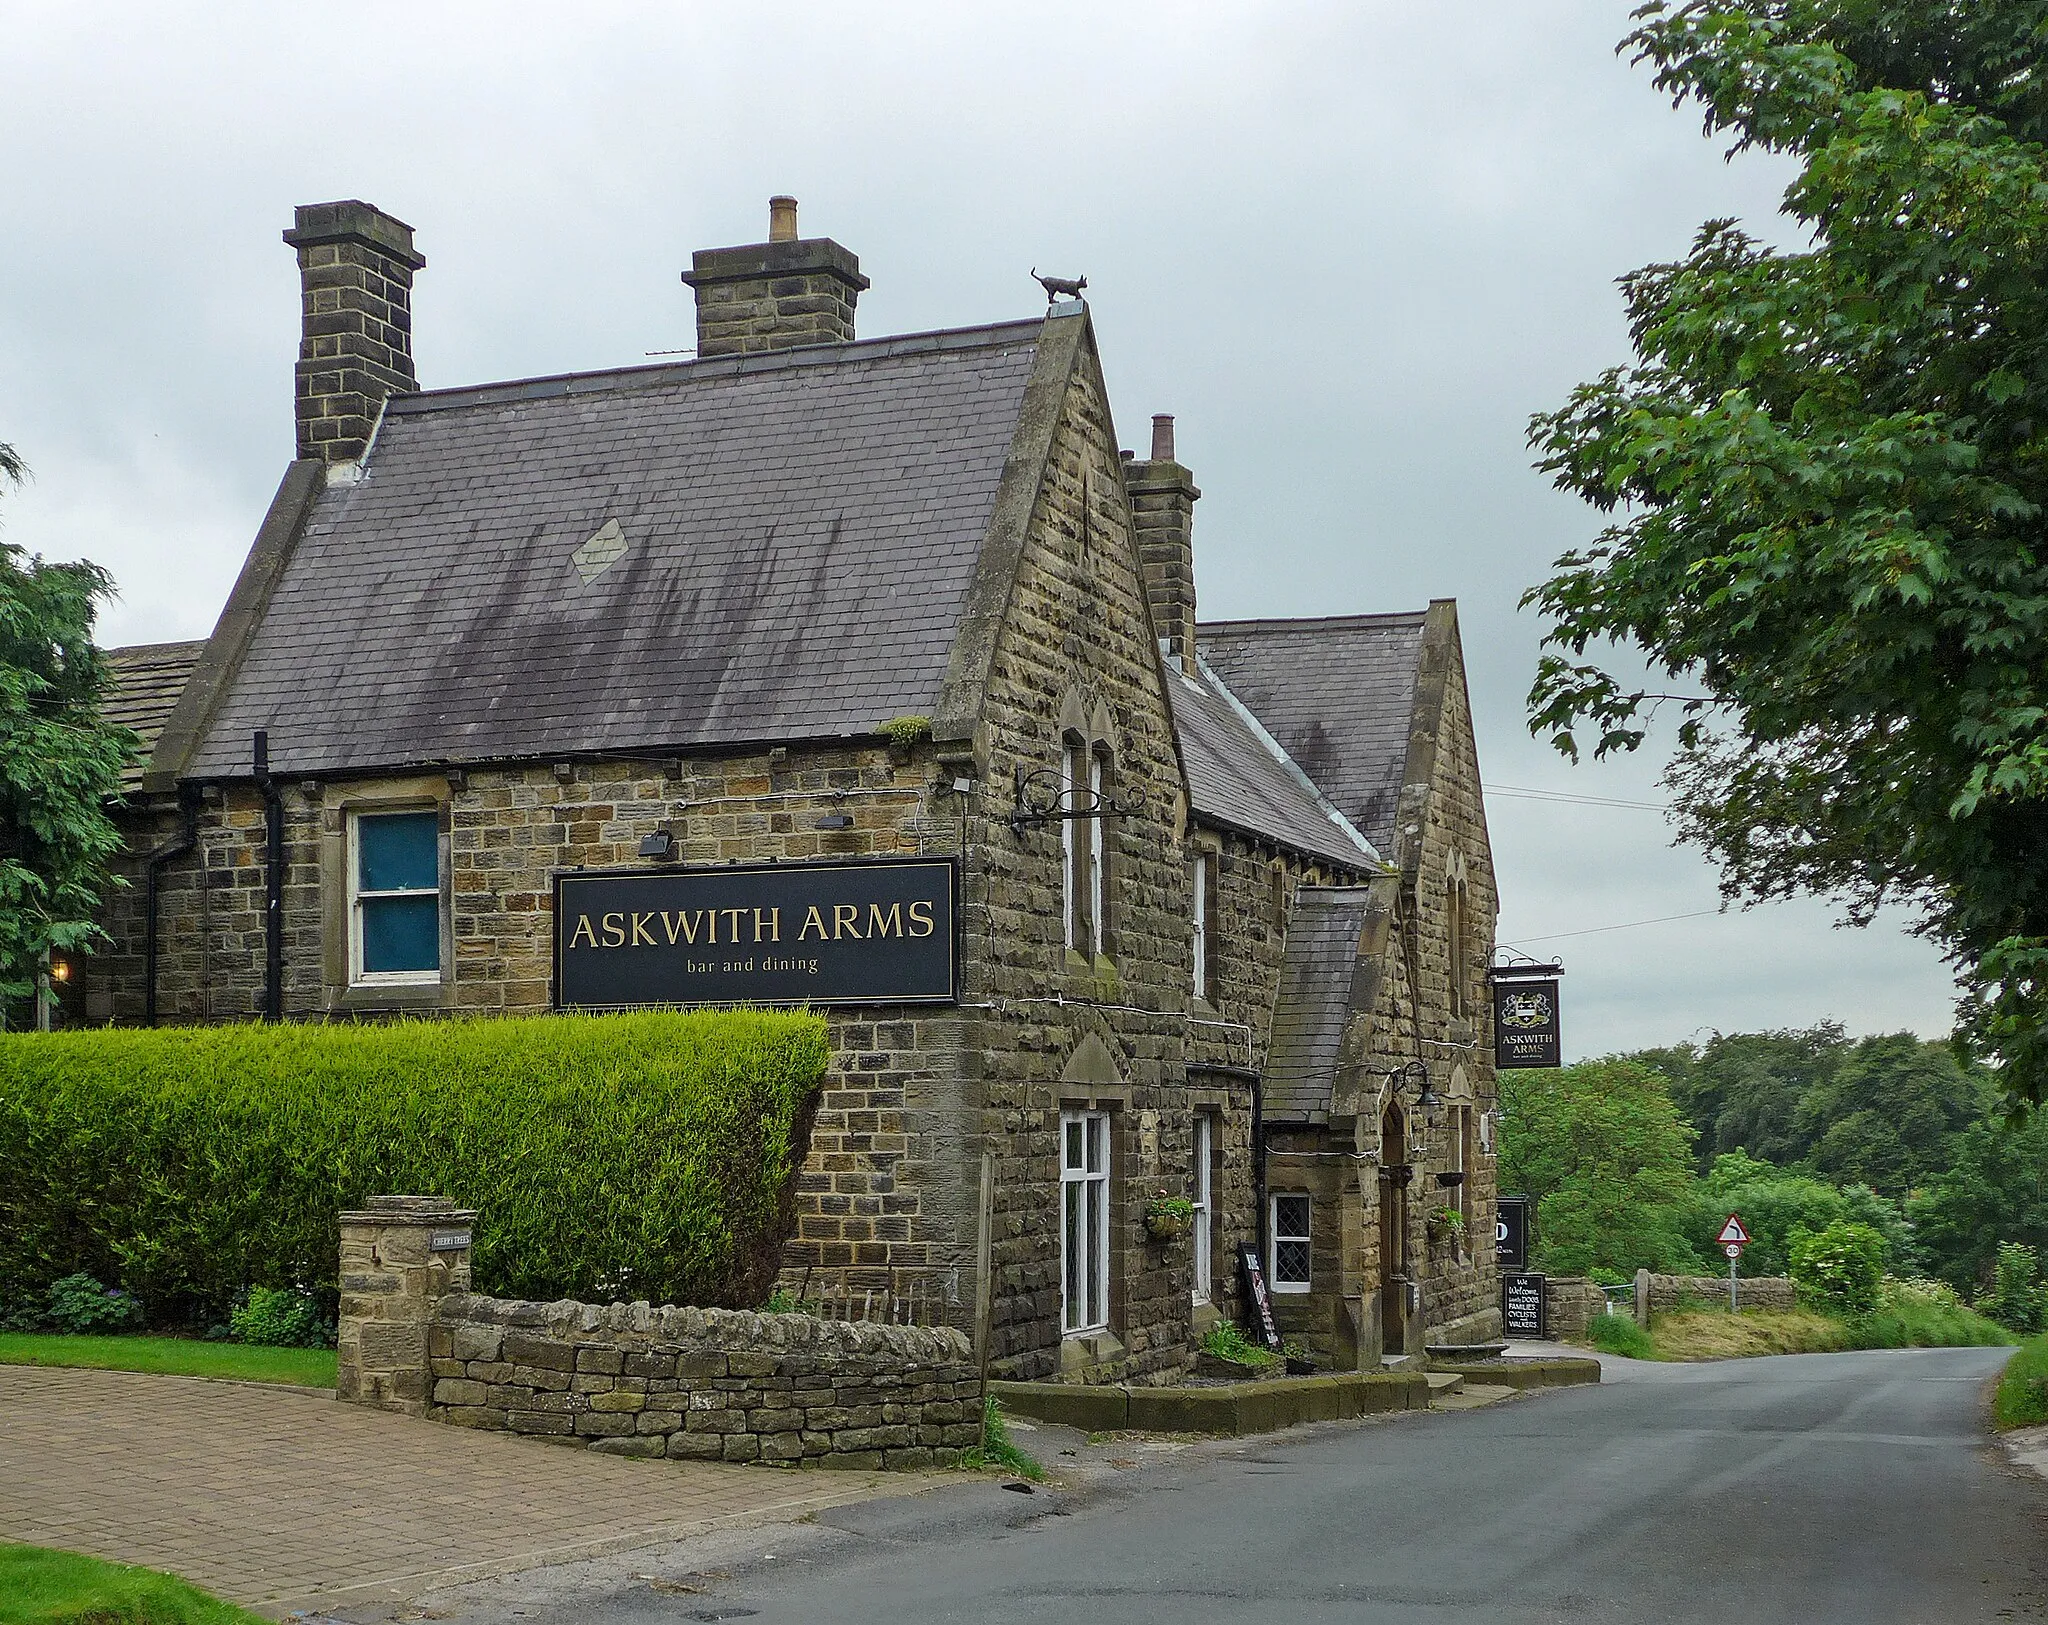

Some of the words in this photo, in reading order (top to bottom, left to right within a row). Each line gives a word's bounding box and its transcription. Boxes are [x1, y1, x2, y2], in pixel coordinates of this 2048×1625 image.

[568, 906, 781, 949] ASKWITH
[797, 900, 935, 942] ARMS
[686, 957, 716, 974] bar
[723, 956, 754, 973] and
[762, 955, 819, 975] dining
[1502, 1034, 1553, 1044] ASKWITH
[1512, 1045, 1544, 1053] ARMS
[1516, 1278, 1528, 1286] We
[1507, 1310, 1537, 1319] CYCLISTS
